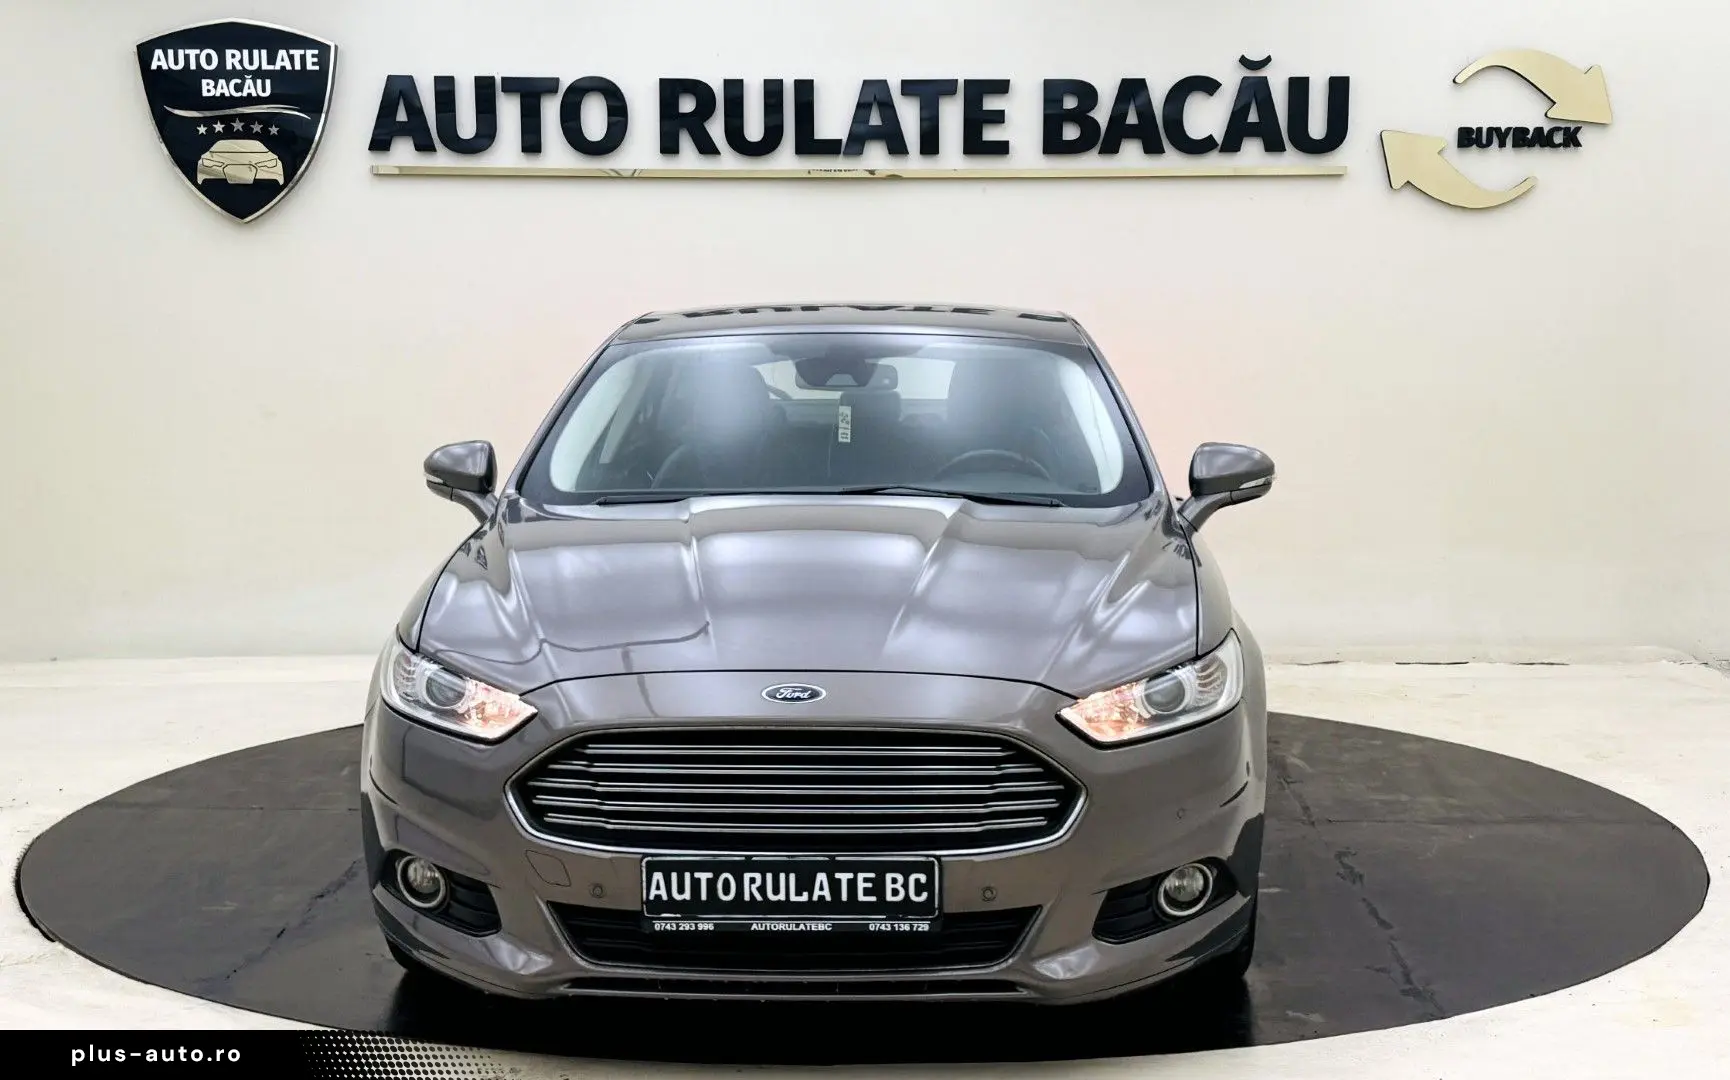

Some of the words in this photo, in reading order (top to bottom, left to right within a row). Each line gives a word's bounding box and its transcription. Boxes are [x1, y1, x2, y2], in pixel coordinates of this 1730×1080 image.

[151, 49, 219, 71] AUTO
[225, 49, 320, 71] RULATE
[201, 75, 272, 97] BACĂU
[367, 74, 629, 155] AUTO
[659, 78, 1011, 156] RULATE
[1042, 54, 1351, 155] BACĂU
[1457, 126, 1583, 149] BUYBACK
[775, 687, 812, 699] Ford
[885, 872, 929, 902] BC
[654, 922, 676, 931] 0743
[678, 922, 696, 931] 293
[750, 922, 833, 931] AUTORULATEBC
[869, 923, 891, 931] 0743
[893, 923, 911, 931] 136
[912, 923, 930, 931] 729
